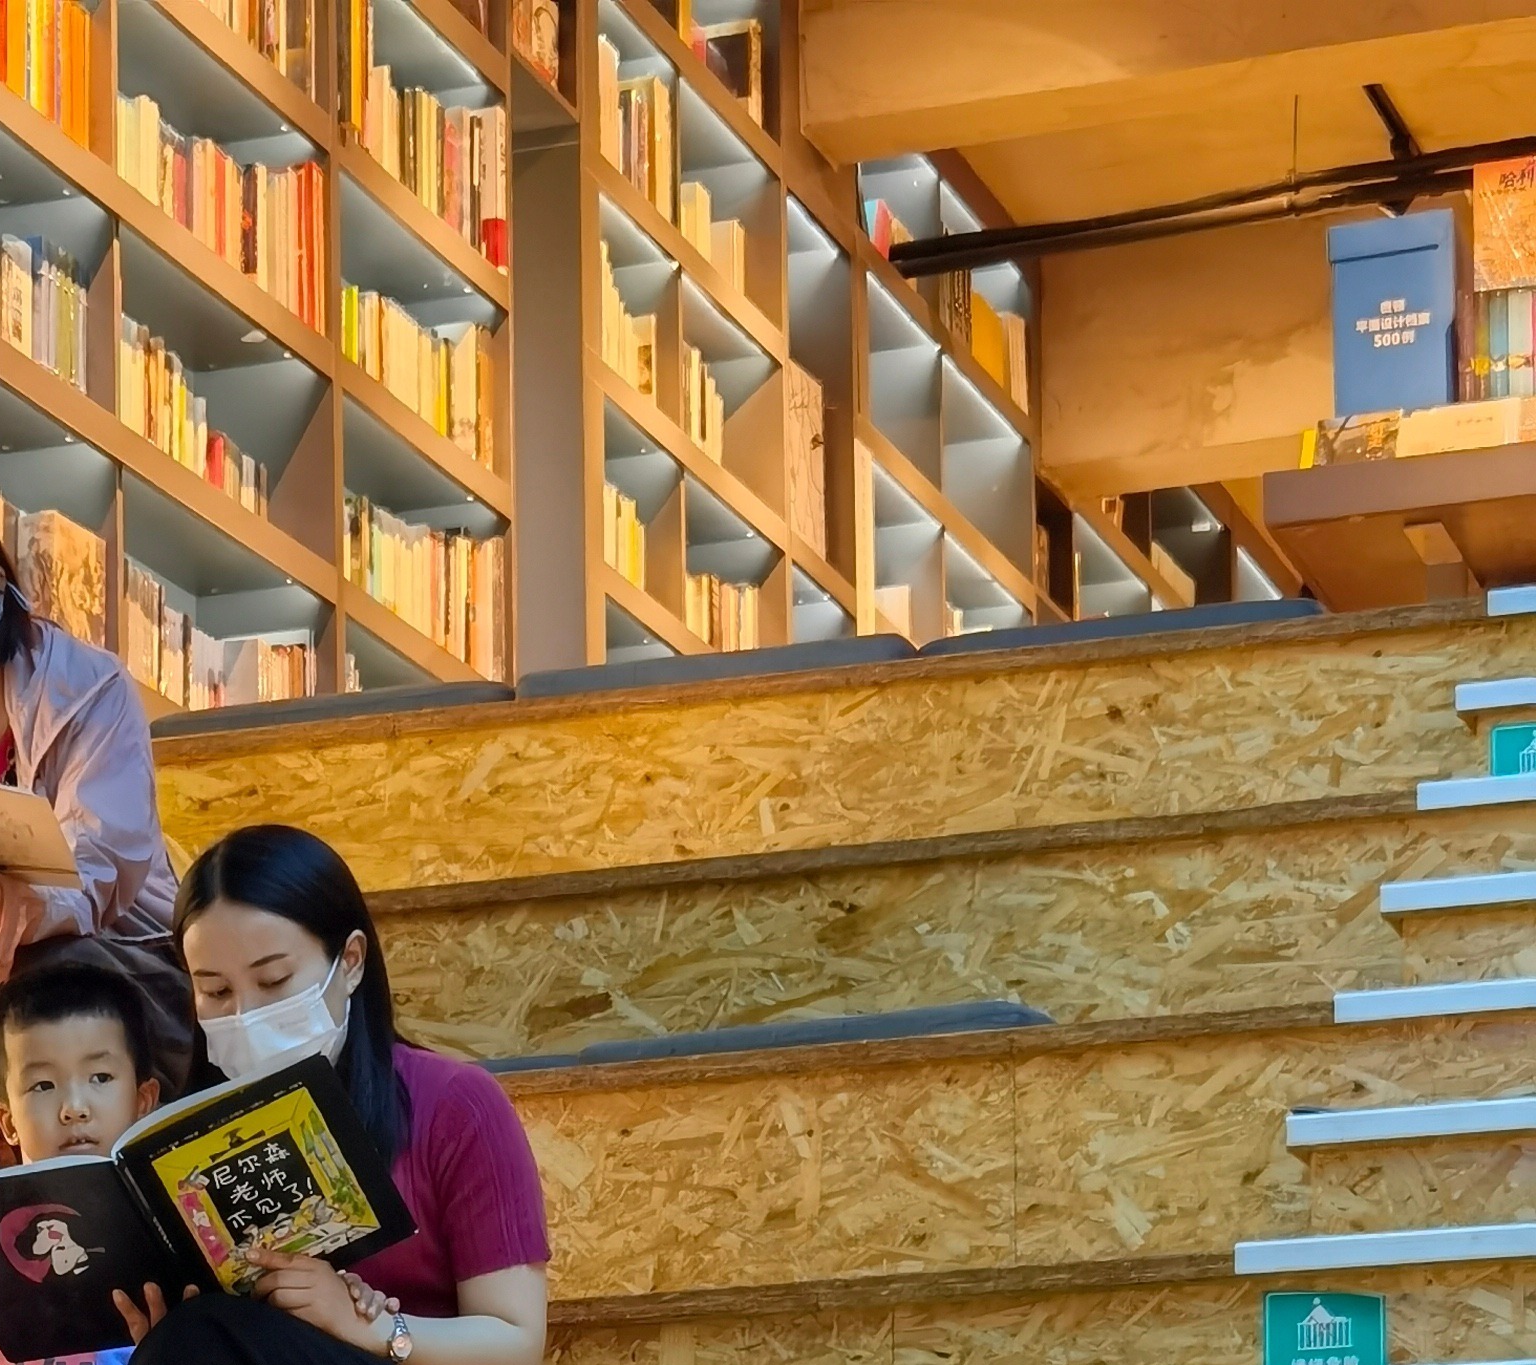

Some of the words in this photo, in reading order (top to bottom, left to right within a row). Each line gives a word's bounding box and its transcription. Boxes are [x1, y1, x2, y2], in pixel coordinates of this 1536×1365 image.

[211, 1142, 291, 1190] 尼尔森
[230, 1168, 288, 1204] 老师
